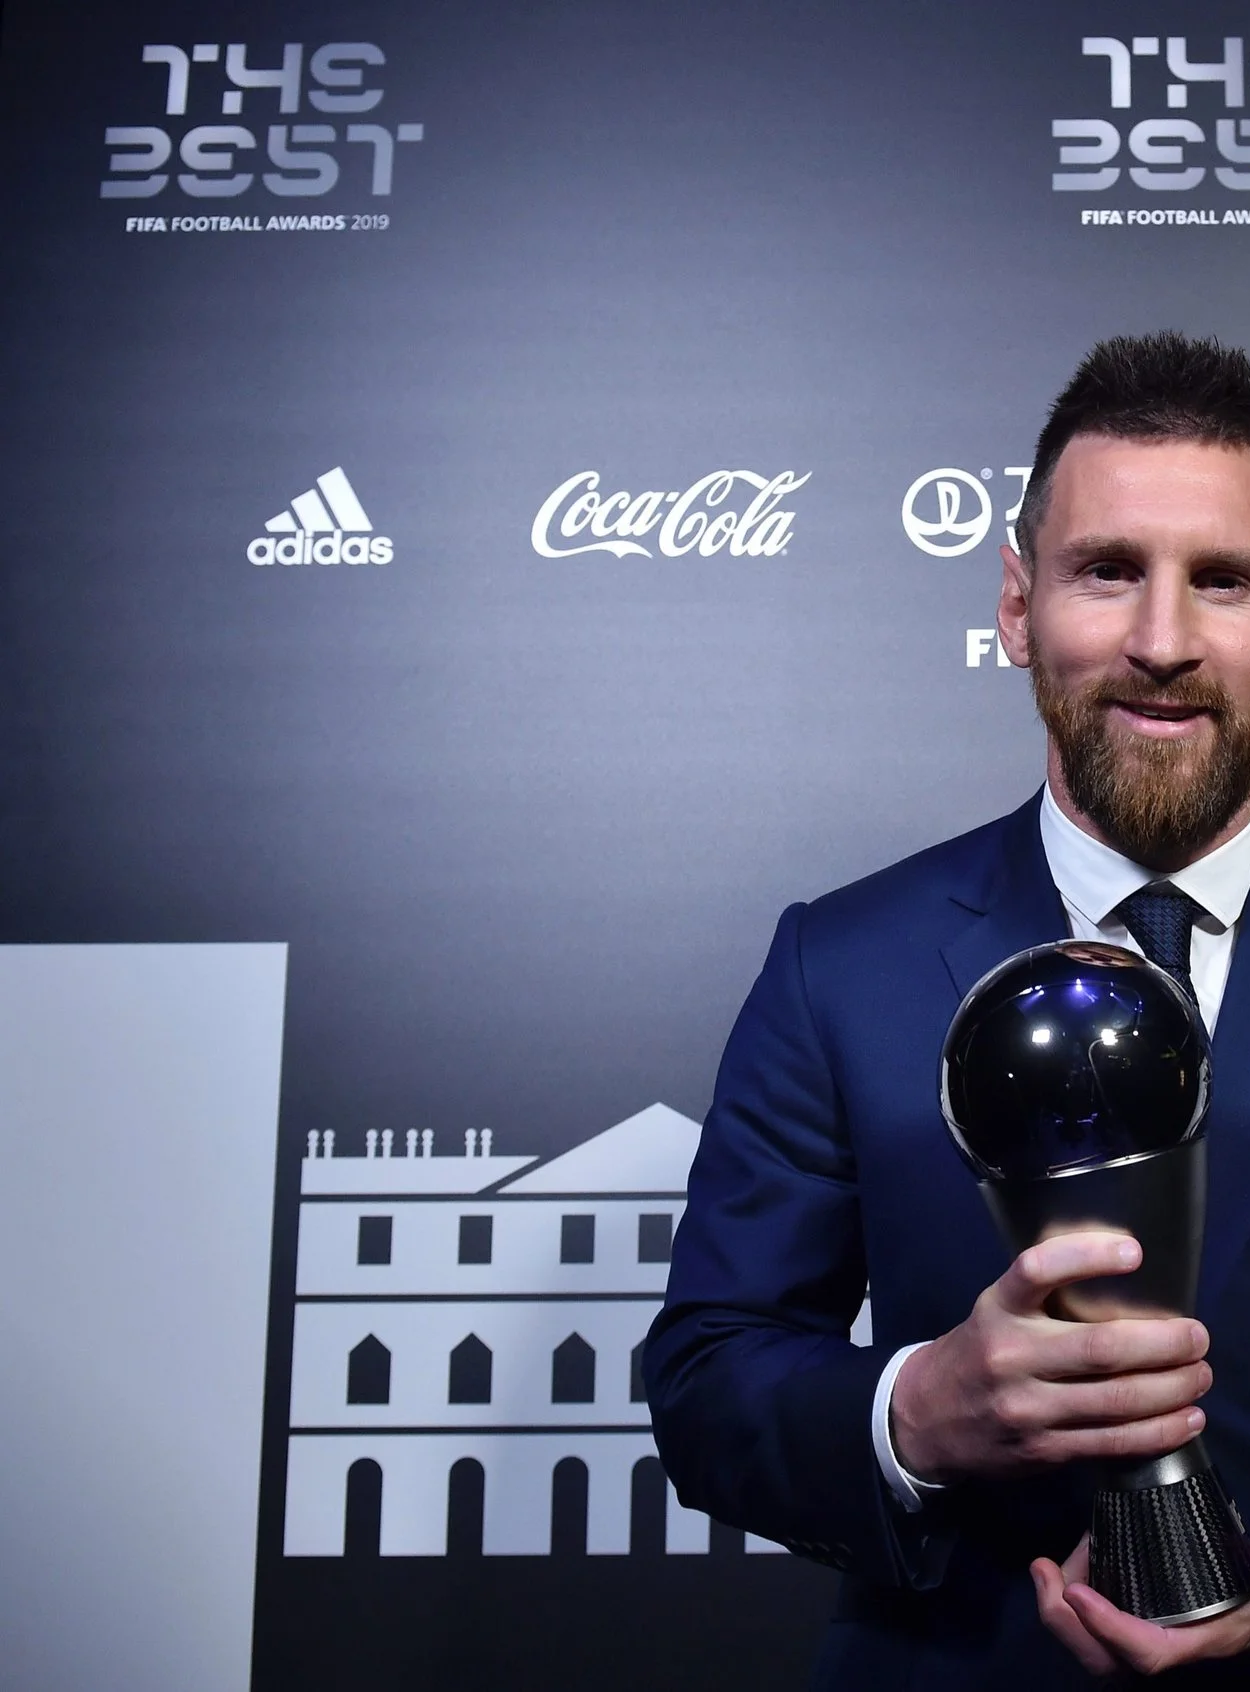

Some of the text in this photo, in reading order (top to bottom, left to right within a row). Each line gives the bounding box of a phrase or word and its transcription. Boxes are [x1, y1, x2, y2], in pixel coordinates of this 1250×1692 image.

[142, 42, 387, 116] THE
[100, 123, 425, 199] BEST
[126, 214, 390, 233] FIFA FOOTBALL AWARDS 2019
[1081, 209, 1123, 225] FIFA
[1127, 209, 1220, 225] FOOTBALL
[531, 470, 813, 558] Coca-Cola
[246, 529, 394, 566] adidas
